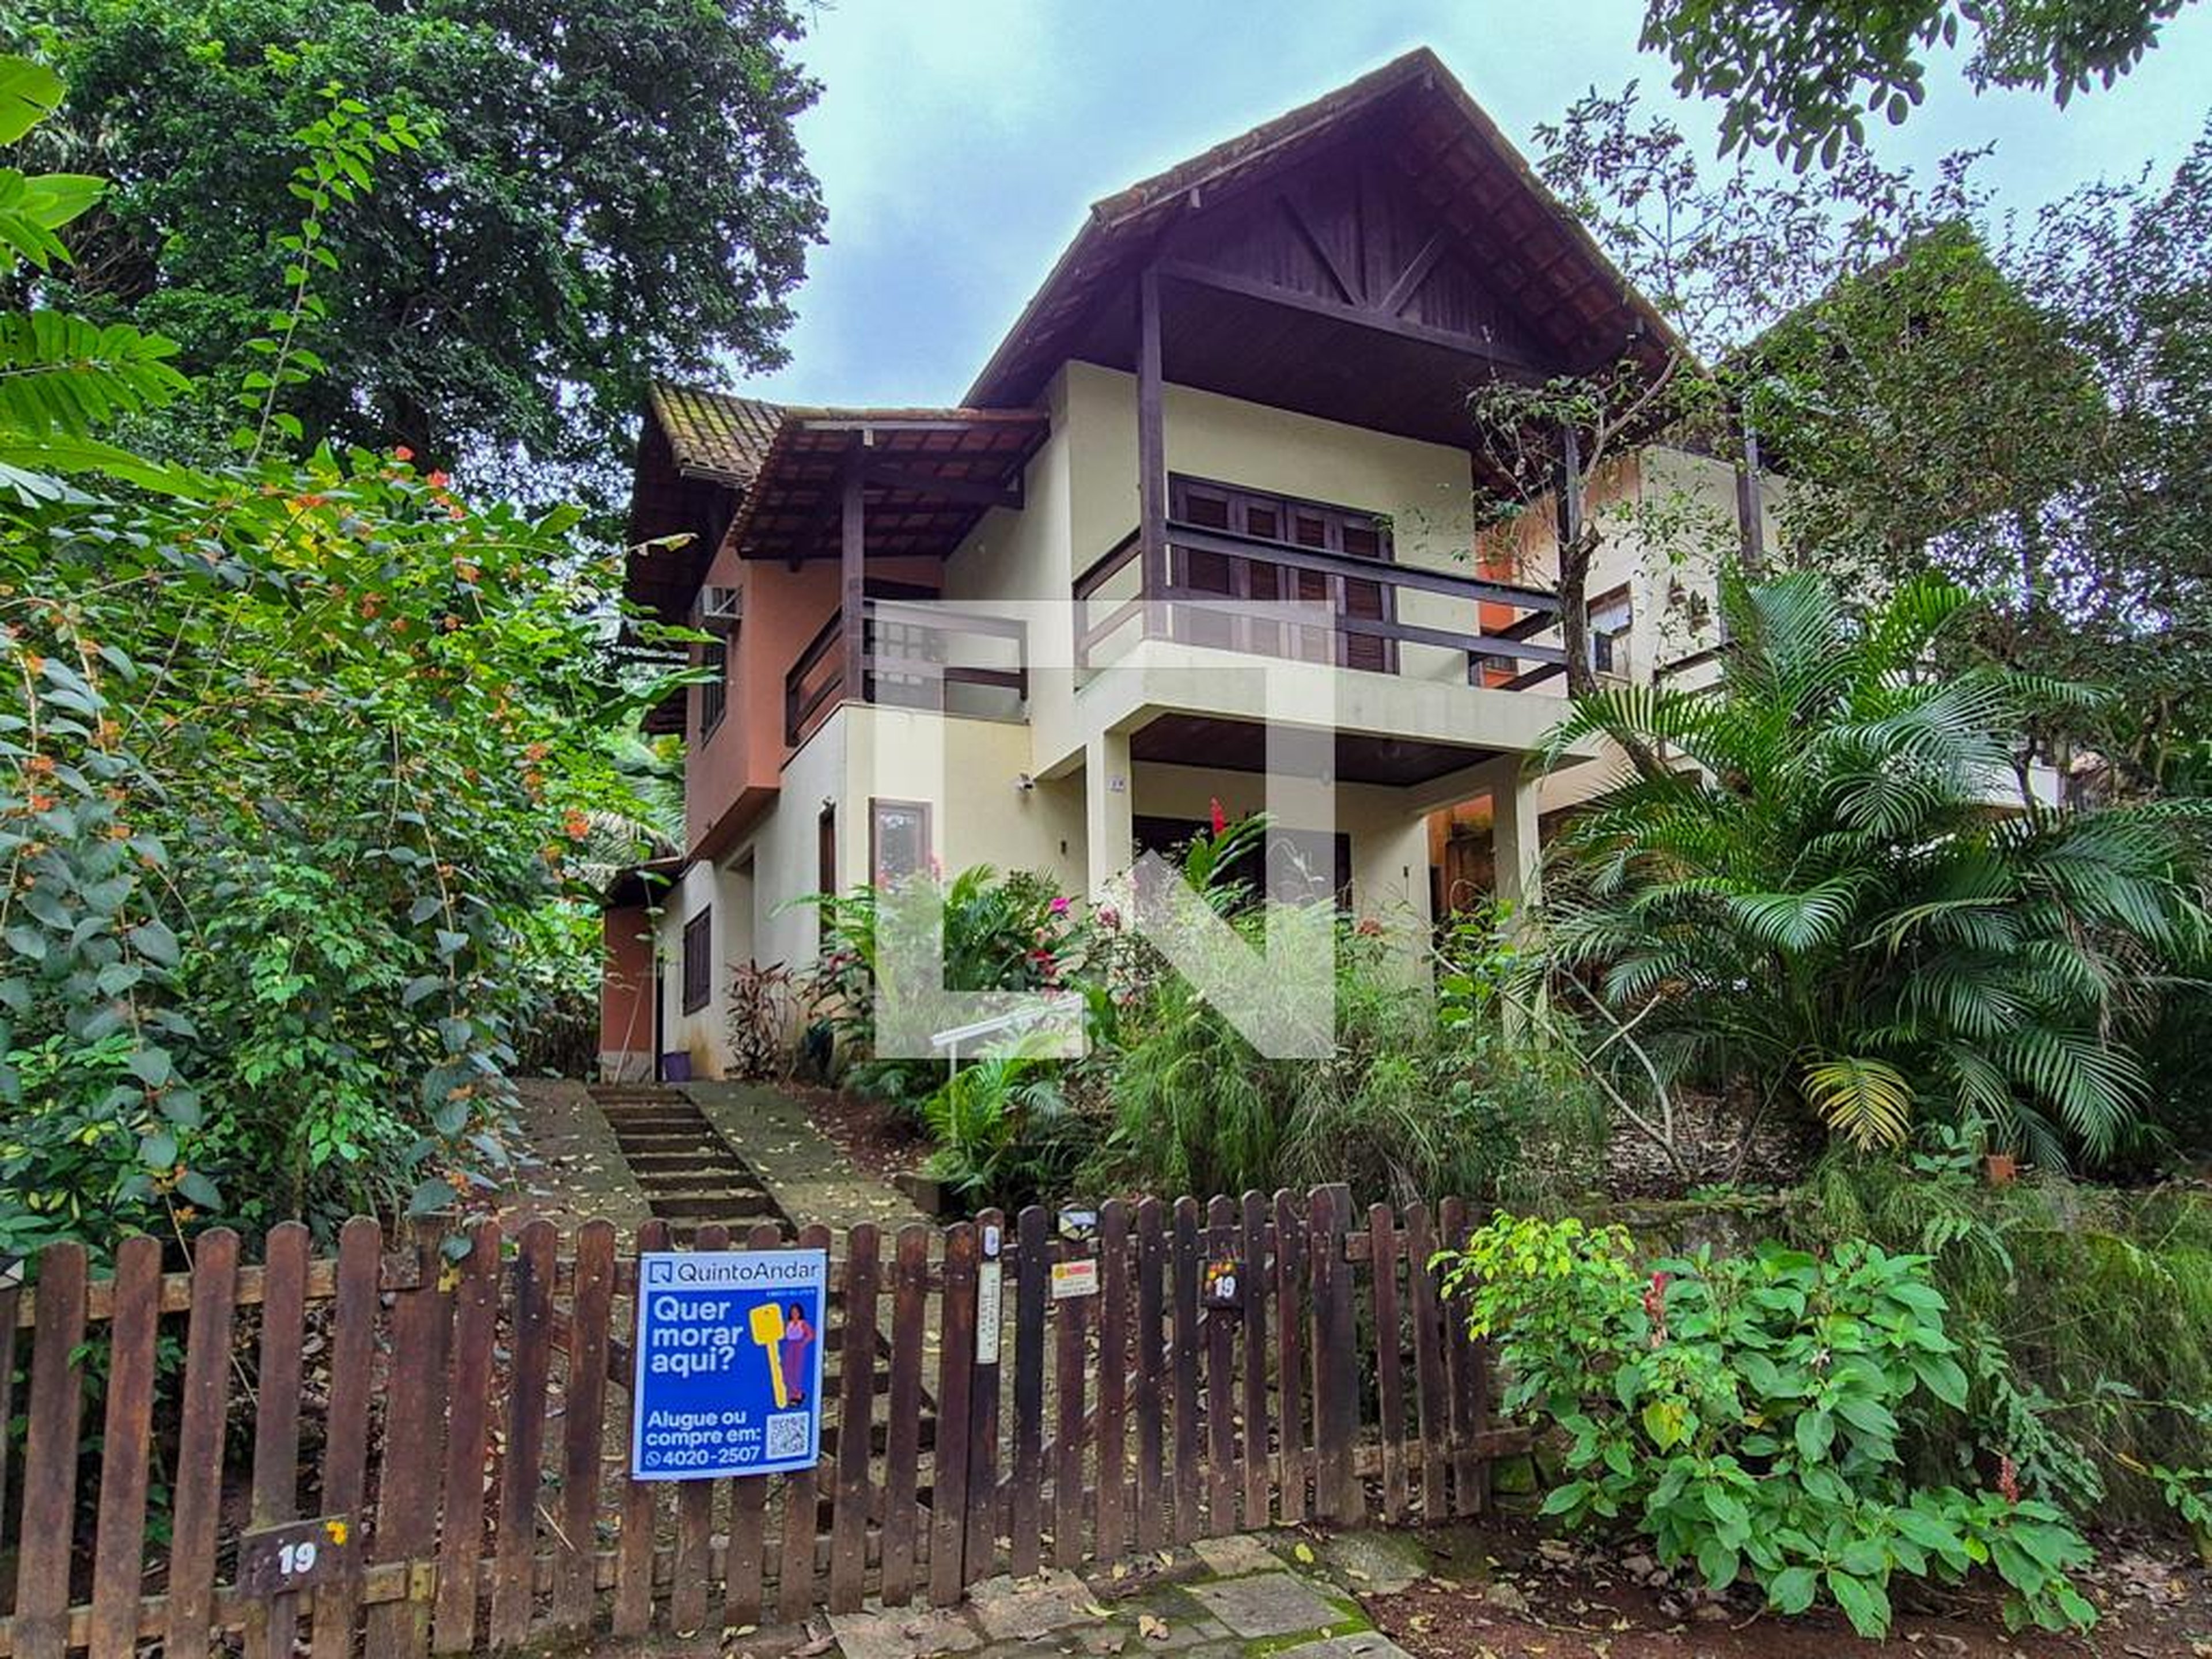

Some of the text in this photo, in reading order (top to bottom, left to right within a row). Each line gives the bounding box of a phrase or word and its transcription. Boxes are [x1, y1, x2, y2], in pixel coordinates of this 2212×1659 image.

[677, 1262, 817, 1281] QuintoAndar
[1214, 1276, 1236, 1297] 19
[654, 1296, 731, 1321] Quer
[653, 1326, 744, 1346] morar
[652, 1346, 735, 1378] aqui?
[647, 1411, 746, 1430] Alugue ou
[646, 1427, 761, 1448] compre em:
[278, 1542, 317, 1574] 19
